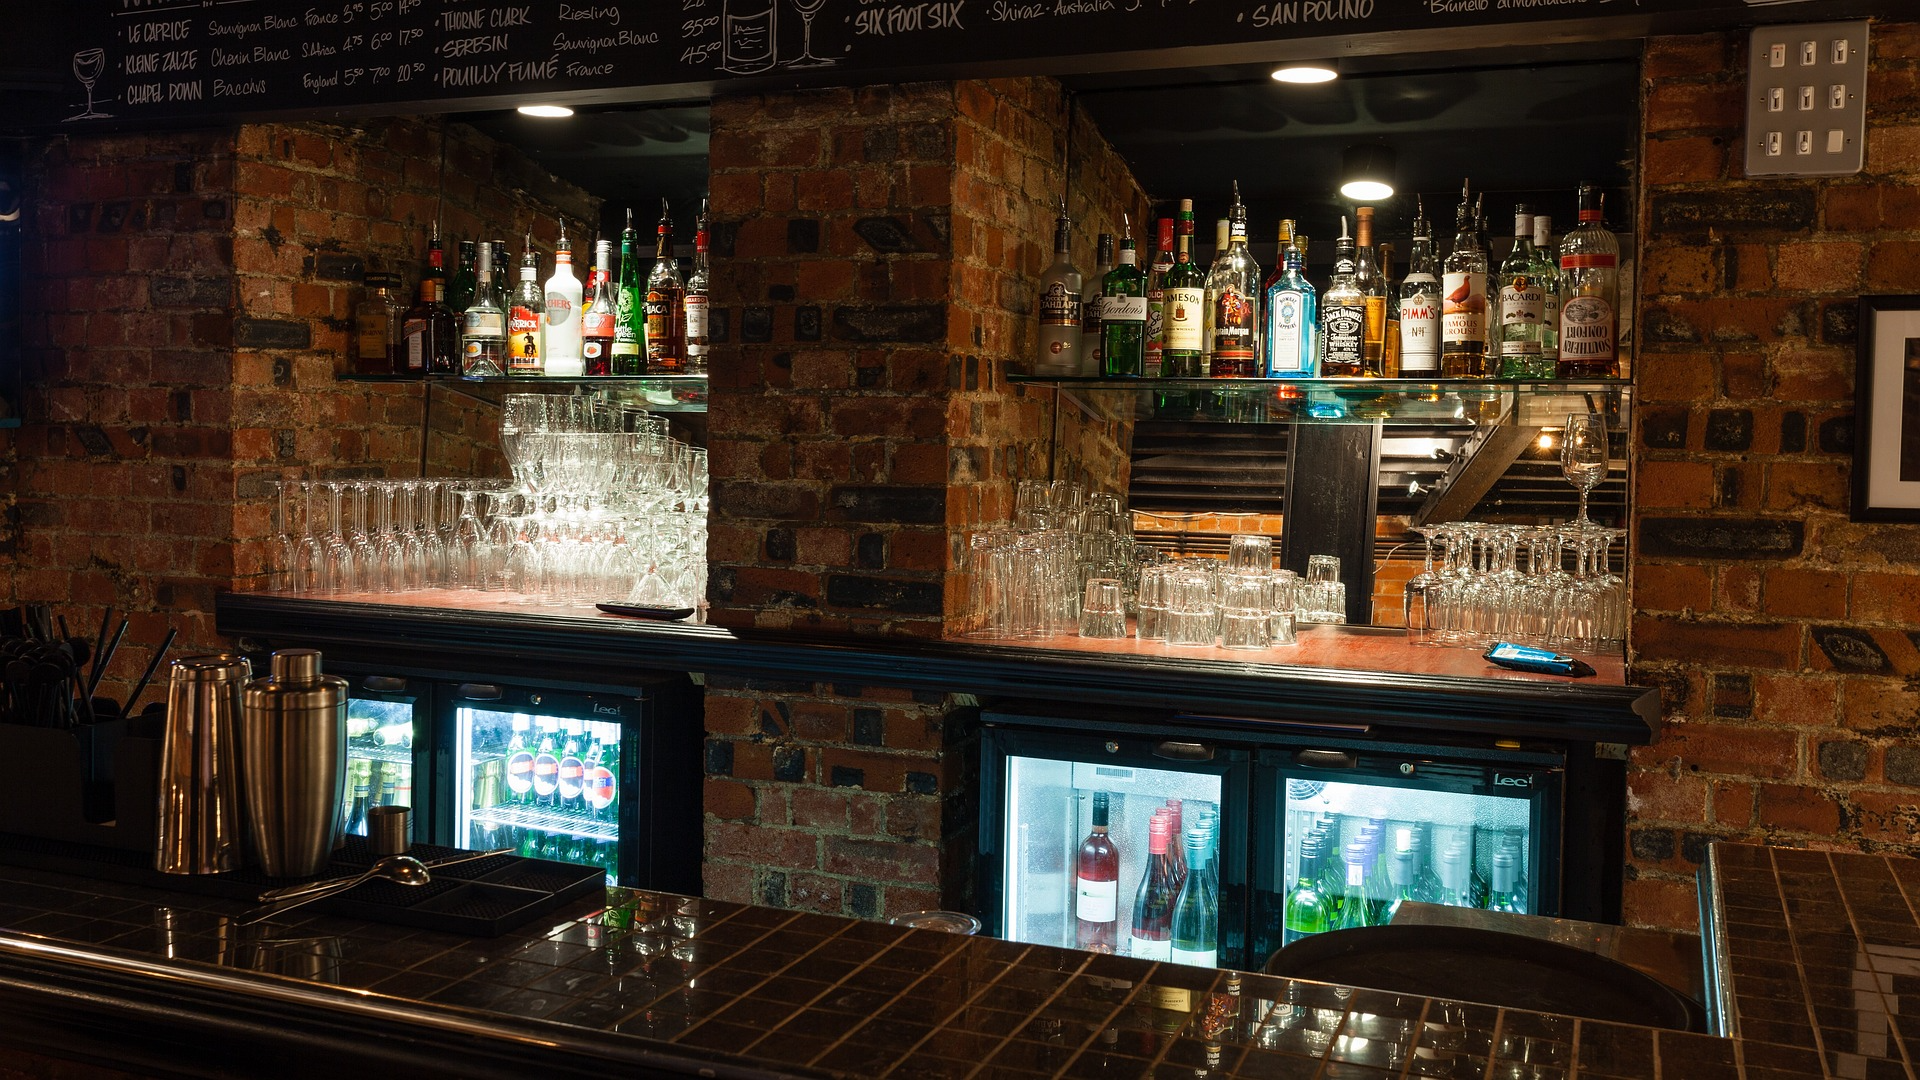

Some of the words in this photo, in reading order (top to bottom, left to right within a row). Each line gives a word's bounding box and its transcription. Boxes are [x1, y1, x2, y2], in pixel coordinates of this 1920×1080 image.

[128, 23, 142, 44] LE
[143, 19, 192, 42] CAPRICE
[208, 20, 262, 40] Sauvignon
[264, 15, 298, 30] Blanc
[304, 8, 339, 27] France
[370, 1, 394, 21] 5.00
[440, 9, 486, 31] THORNE
[489, 5, 532, 29] CLARK
[558, 4, 621, 26] Riesling
[854, 7, 886, 36] SIX
[888, 2, 929, 34] FOOT
[926, 0, 965, 31] SIX
[991, 0, 1046, 21] Shiraz
[1054, 0, 1116, 16] Australia
[1251, 6, 1298, 28] SAN
[1303, 0, 1373, 23] POLINO
[442, 33, 509, 59] SERESIN
[552, 32, 617, 54] Sauvignon
[618, 30, 660, 46] Blanc
[682, 15, 720, 38] 35.00
[125, 52, 160, 75] KLEINE
[162, 49, 198, 72] ZALZE
[211, 48, 251, 67] Chenin
[253, 46, 291, 62] Blanc
[343, 34, 363, 52] 4.75
[370, 32, 393, 51] 6.00
[398, 29, 424, 46] 17.50
[442, 61, 507, 88] POUILLY
[508, 53, 560, 81] FUMÉ
[565, 61, 615, 78] France
[680, 40, 722, 65] 45.00
[127, 82, 165, 105] CHAPEL
[168, 79, 203, 101] DOWN
[213, 78, 267, 98] Bacchus
[303, 71, 338, 94] England
[343, 68, 365, 86] 5.50
[369, 66, 391, 84] 7.00
[397, 62, 426, 83] 20.50
[1163, 293, 1201, 305] JAMESON
[1502, 292, 1541, 302] BACARDI
[1102, 302, 1144, 315] Gordon's
[1402, 304, 1436, 320] PIMM'S
[1444, 327, 1477, 336] GROUSE
[1445, 320, 1478, 328] FAMOUS
[1566, 325, 1608, 339] COMFORT
[1562, 340, 1612, 355] SOUTHERN
